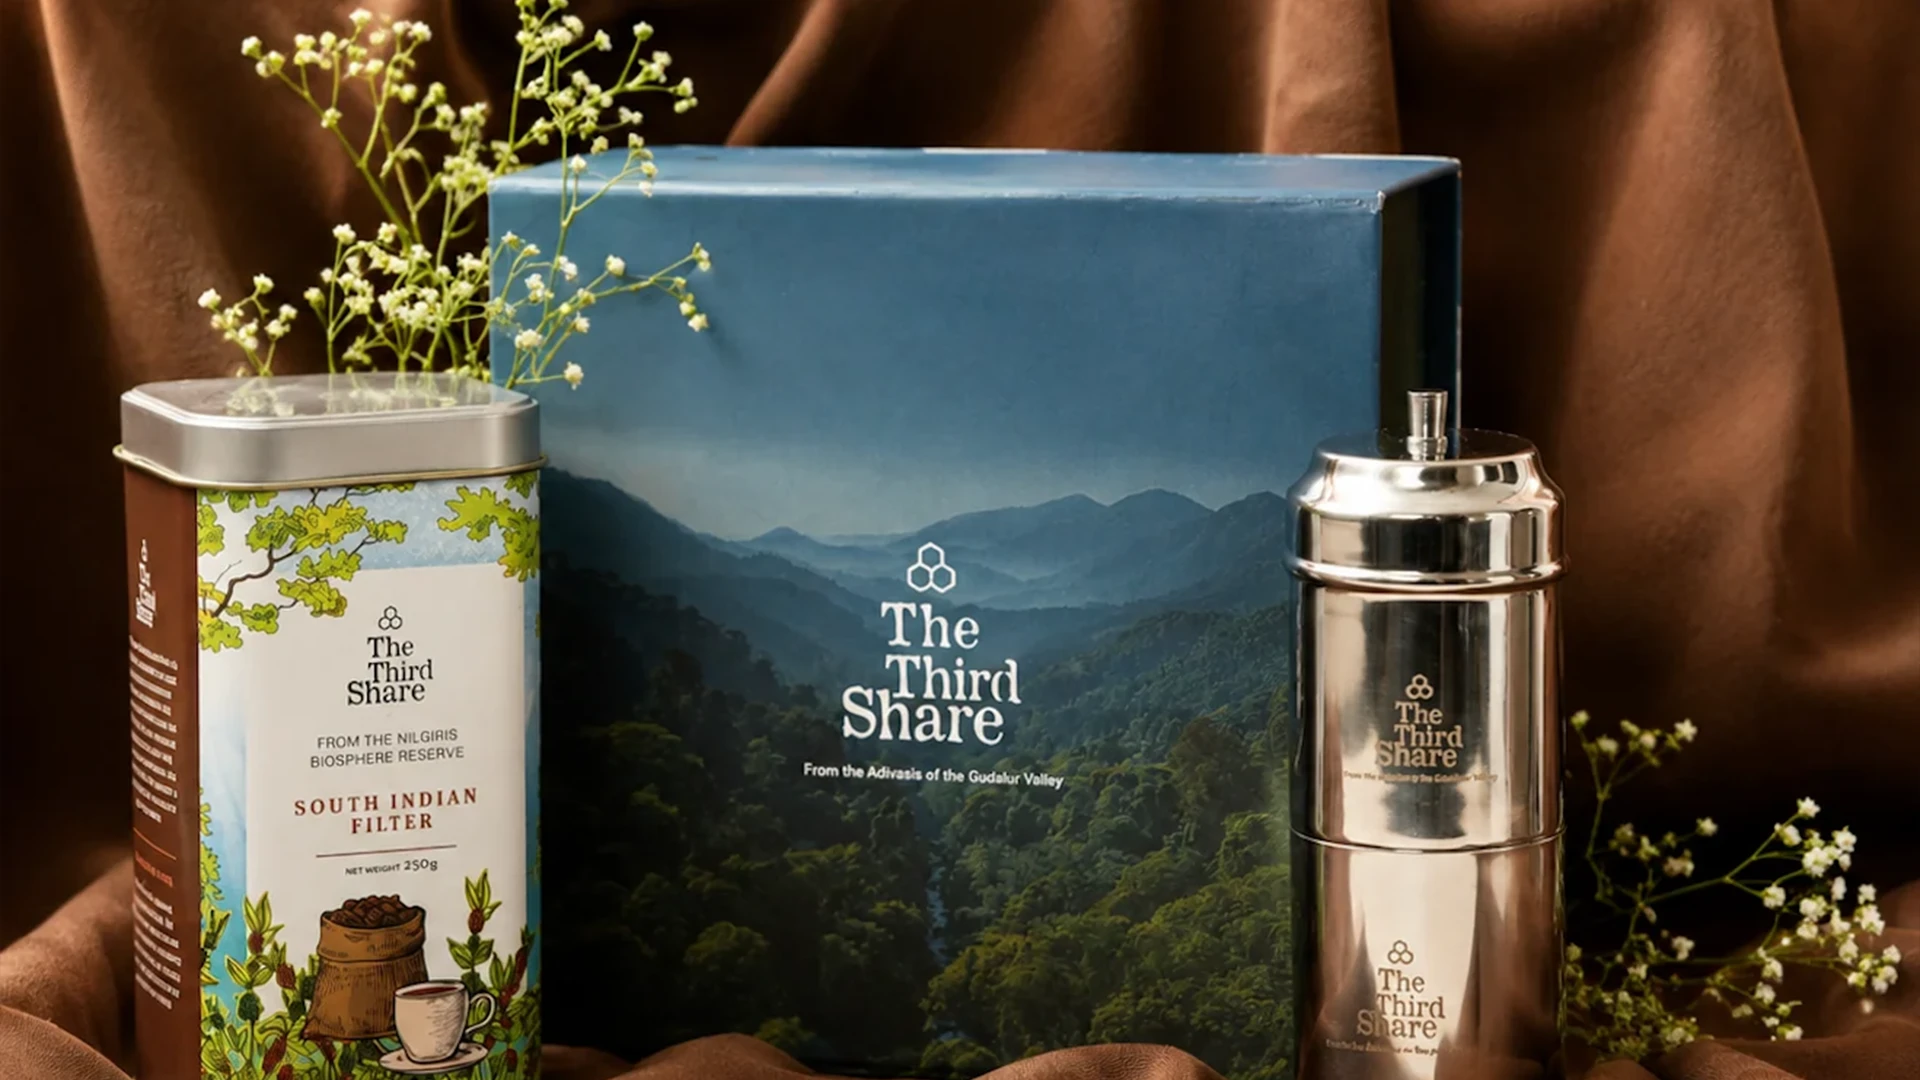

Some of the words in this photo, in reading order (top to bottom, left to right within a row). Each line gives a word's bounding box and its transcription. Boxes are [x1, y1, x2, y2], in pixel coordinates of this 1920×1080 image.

[881, 601, 980, 650] The
[367, 636, 414, 658] The
[368, 659, 433, 683] Third
[885, 654, 1021, 704] Third
[347, 680, 425, 706] Share
[842, 685, 1004, 746] Share
[1395, 701, 1443, 724] The
[317, 735, 360, 749] FROM
[364, 733, 393, 747] THE
[397, 728, 458, 744] NILGIRIS
[1394, 723, 1464, 748] Third
[310, 751, 393, 768] BIOSPHERE
[398, 746, 464, 763] RESERVE
[1375, 739, 1458, 767] Share
[803, 762, 839, 778] From
[842, 765, 865, 779] the
[867, 766, 923, 781] Adivasis
[925, 768, 941, 782] of
[943, 769, 965, 783] the
[968, 769, 1021, 786] Gudalur
[1023, 773, 1065, 791] Valley
[294, 795, 379, 816] SOUTH
[390, 787, 477, 810] INDIAN
[351, 813, 433, 834] FILTER
[345, 867, 363, 876] NET
[365, 863, 401, 874] WEIGHT
[403, 858, 438, 872] 250g
[1378, 967, 1425, 993] The
[1377, 993, 1446, 1019] Third
[1357, 1008, 1438, 1039] Share
